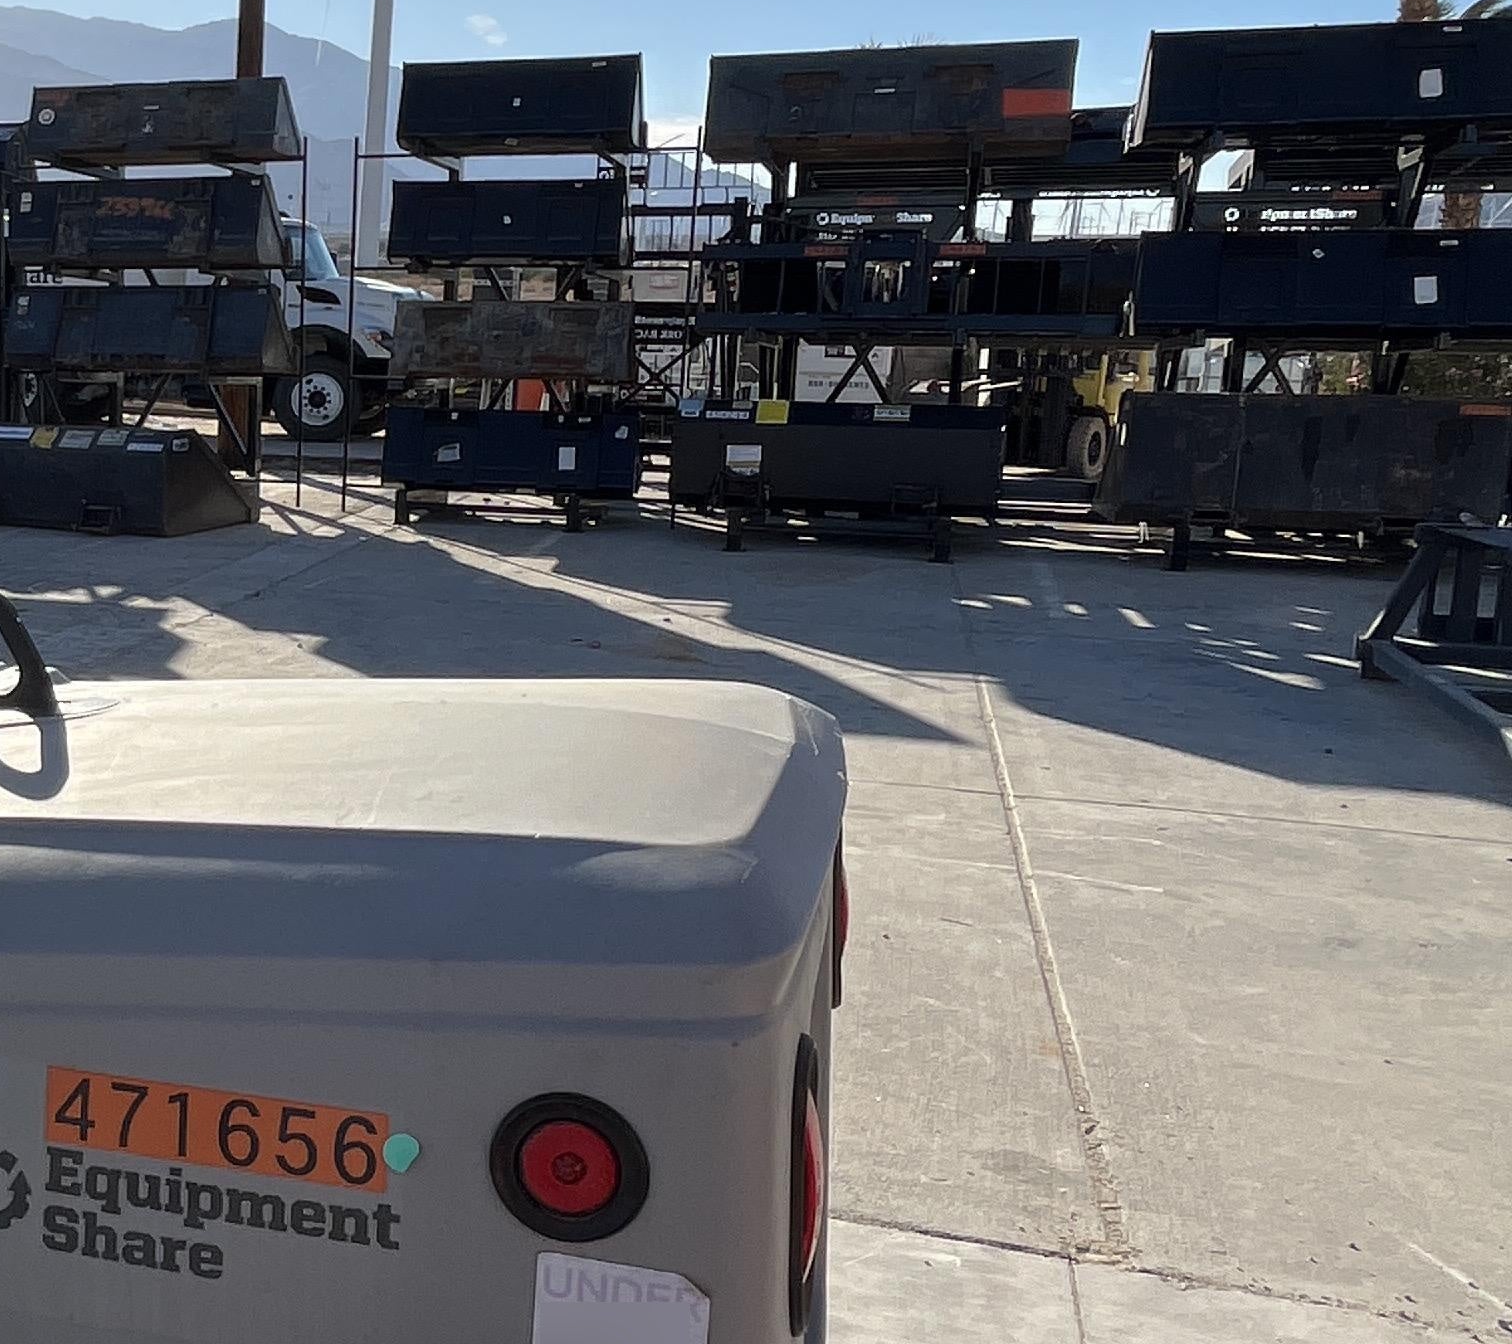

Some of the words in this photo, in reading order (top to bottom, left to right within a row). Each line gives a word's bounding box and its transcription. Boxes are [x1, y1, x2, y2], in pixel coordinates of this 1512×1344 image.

[54, 1077, 378, 1185] 471656
[42, 1205, 224, 1279] Share
[45, 1145, 401, 1250] Equipment
